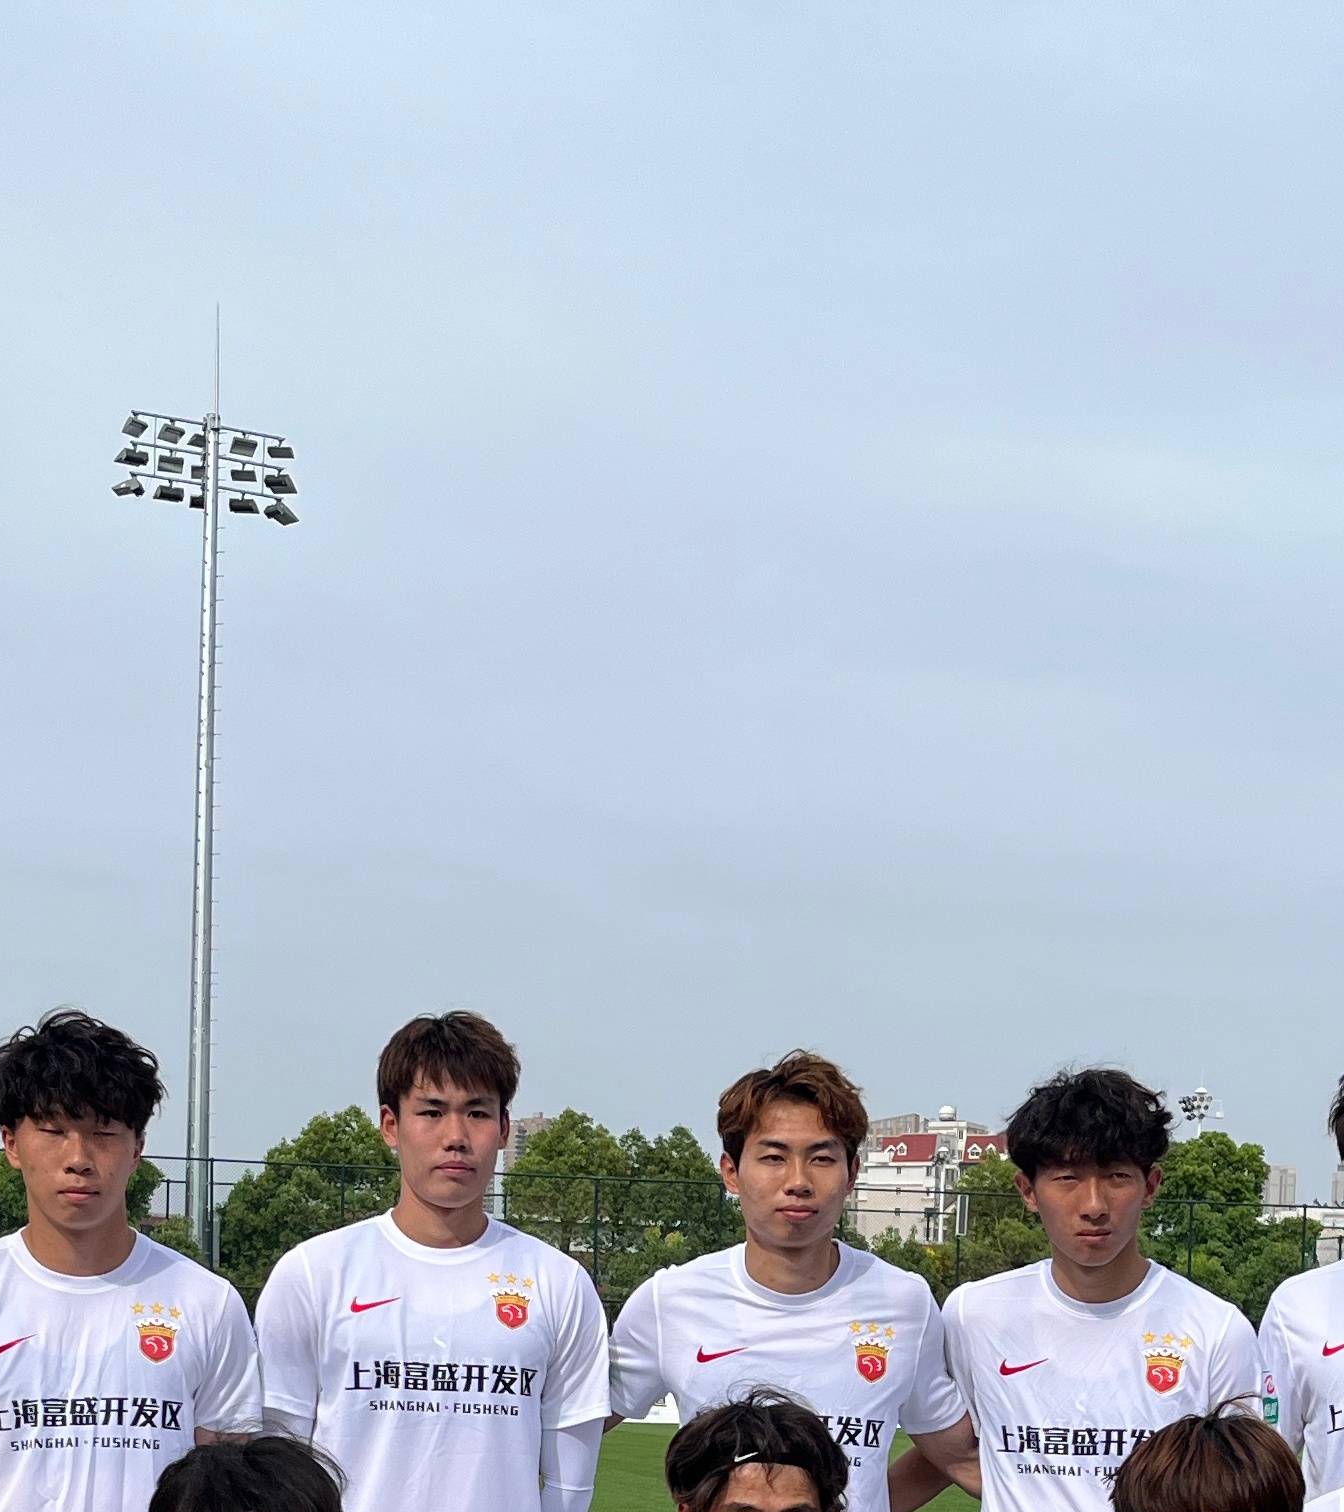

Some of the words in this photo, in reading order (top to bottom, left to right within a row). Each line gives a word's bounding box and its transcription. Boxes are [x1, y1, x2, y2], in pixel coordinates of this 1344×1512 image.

[344, 1360, 538, 1396] 上海富盛开发区
[369, 1401, 440, 1413] SHANGHAI
[453, 1402, 519, 1416] FUSHENG
[92, 1436, 160, 1451] FUSHENG
[1017, 1463, 1082, 1476] SHANGHAI
